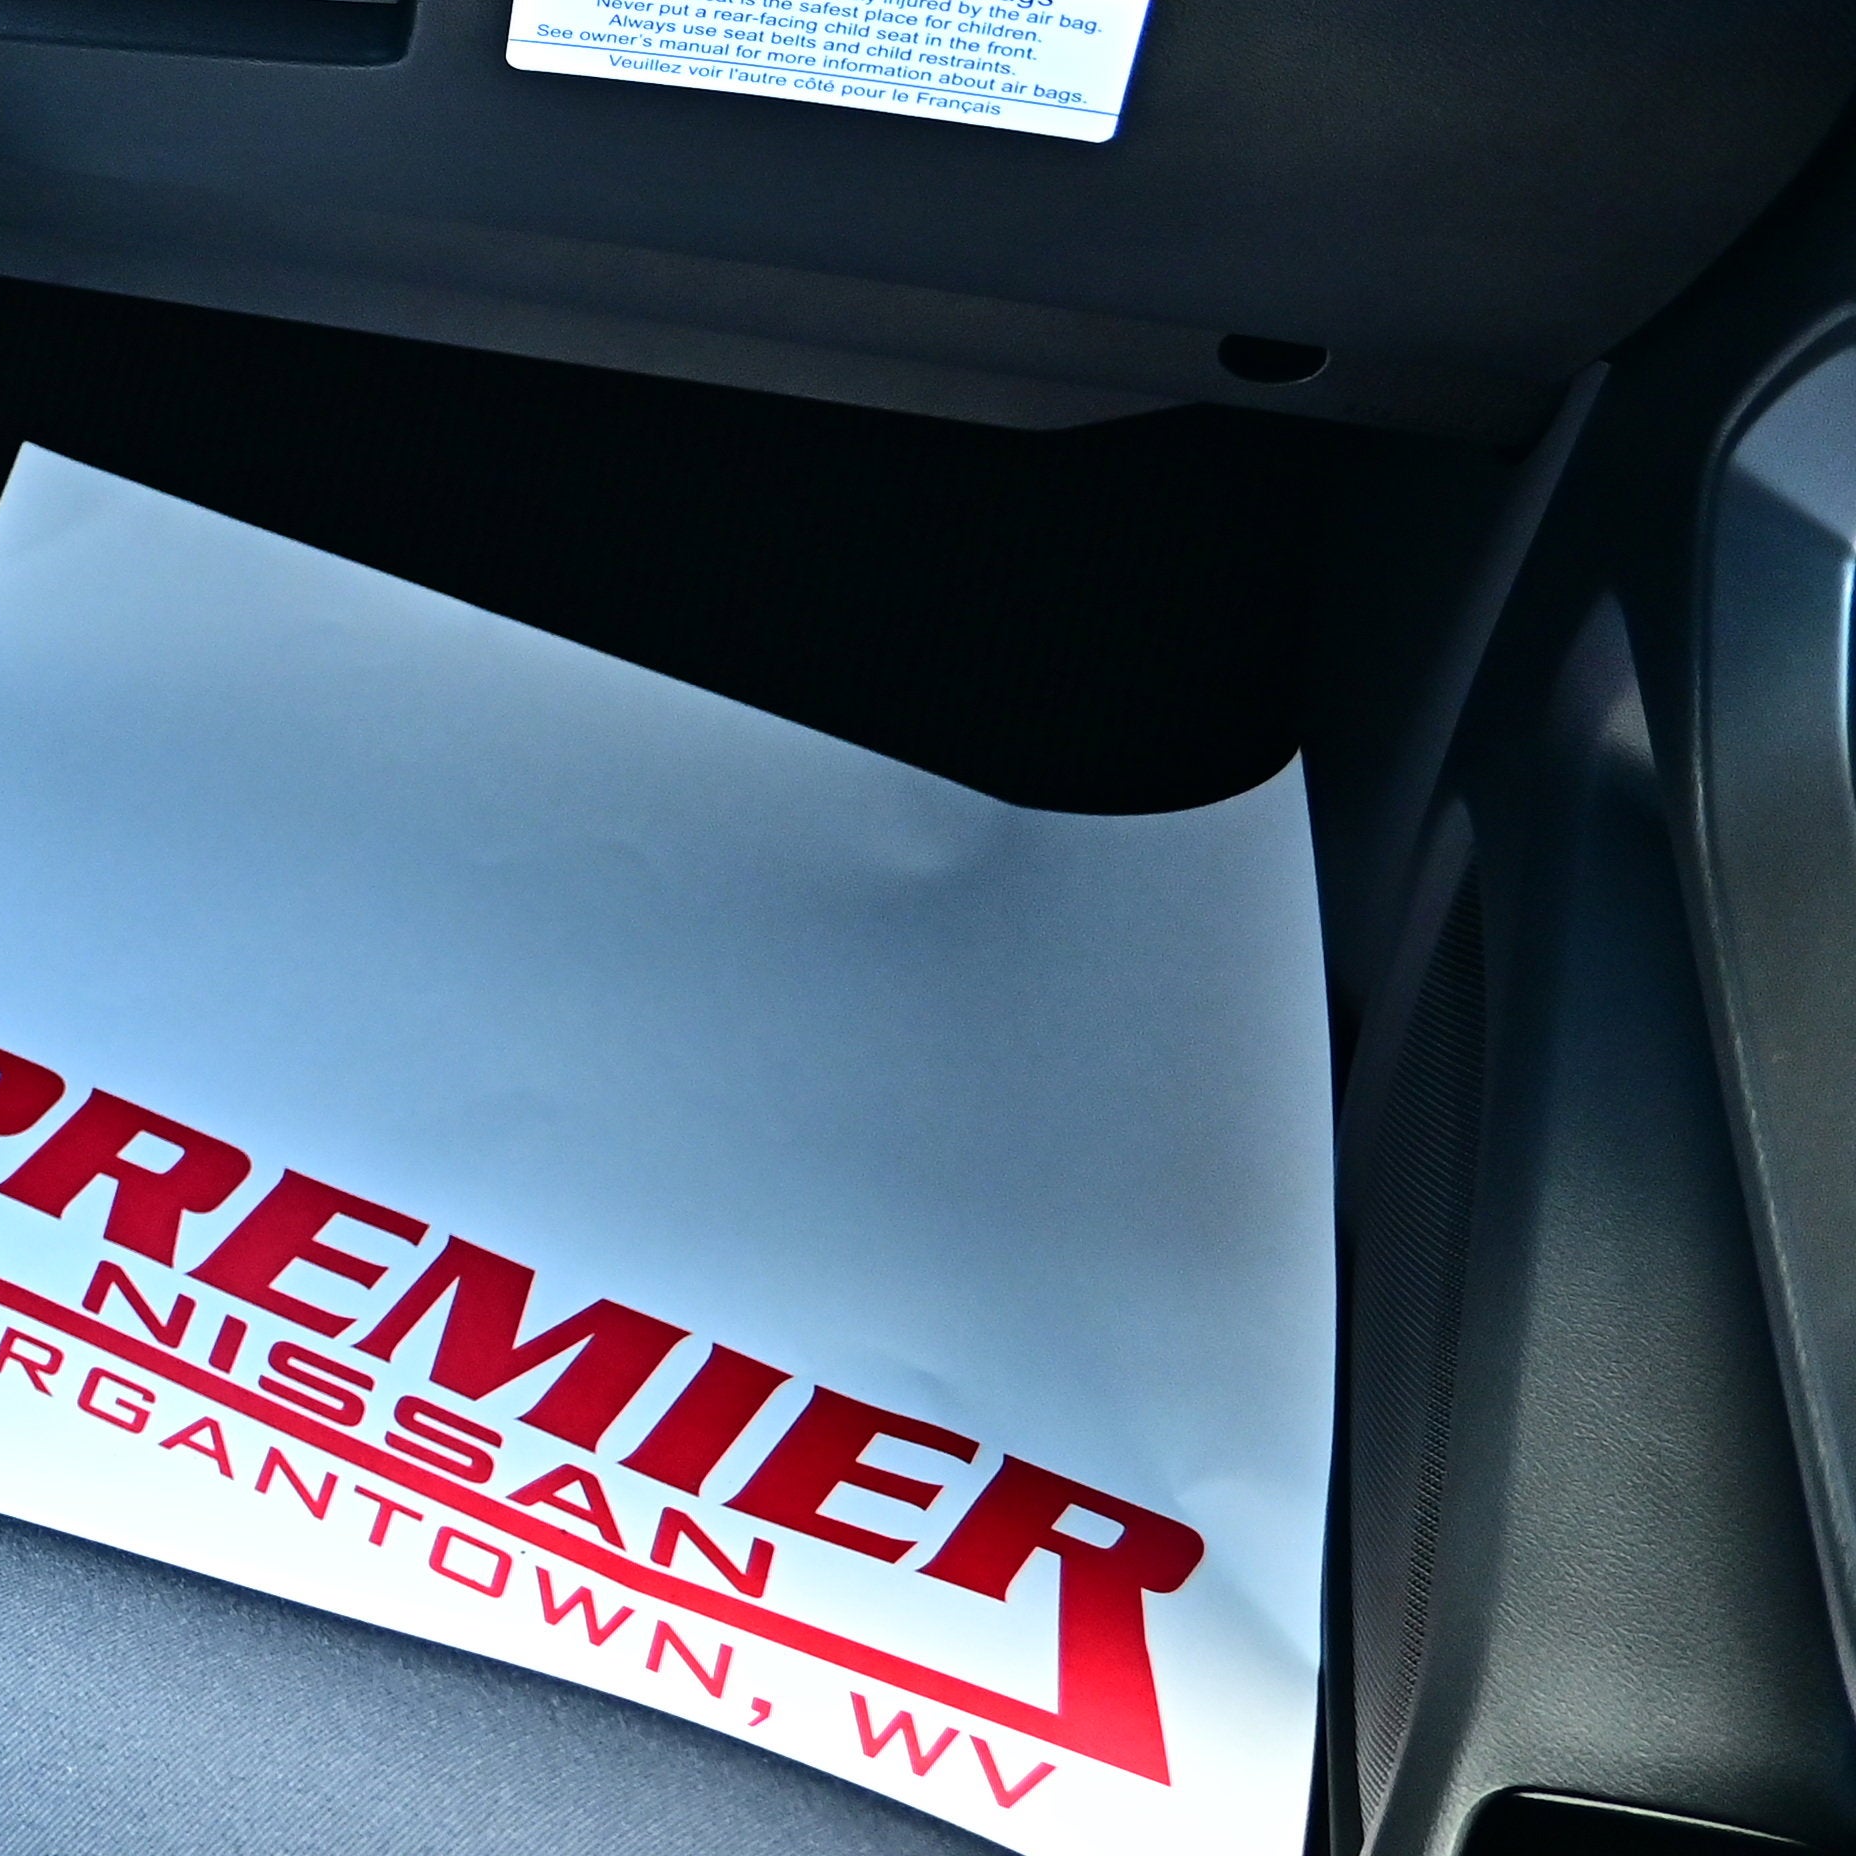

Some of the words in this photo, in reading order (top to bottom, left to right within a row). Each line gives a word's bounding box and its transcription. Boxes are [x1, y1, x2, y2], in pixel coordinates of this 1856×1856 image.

[609, 13, 677, 34] Always
[683, 24, 717, 38] use
[723, 28, 764, 43] seat
[771, 32, 816, 50] belts
[823, 40, 859, 55] and
[866, 43, 912, 62] child
[919, 51, 1016, 76] restraints.
[659, 3, 690, 19] put
[695, 7, 707, 18] a
[714, 9, 818, 35] rear-facing
[824, 22, 870, 38] child
[876, 30, 920, 44] seat
[925, 31, 943, 48] in
[949, 36, 980, 53] the
[987, 40, 1037, 61] front.
[800, 2, 858, 19] safest
[864, 10, 918, 27] place
[925, 14, 953, 31] for
[957, 20, 1042, 43] children.
[989, 5, 1020, 22] the
[1026, 10, 1054, 26] air
[1059, 13, 1102, 35] bag.
[536, 23, 573, 39] See
[580, 29, 652, 48] owner's
[659, 37, 729, 56] manual
[736, 44, 762, 59] for
[768, 50, 816, 67] more
[823, 55, 932, 82] information
[938, 72, 995, 92] about
[1001, 80, 1028, 94] air
[1033, 84, 1087, 104] bags.
[610, 54, 682, 75] Veuillez
[688, 63, 721, 79] voir
[729, 67, 787, 87] l'autre
[793, 74, 835, 92] côté
[841, 83, 886, 100] pour
[893, 87, 909, 102] le
[916, 91, 1002, 116] Français
[81, 1258, 774, 1600] NISSAN
[846, 1690, 1055, 1811] WV
